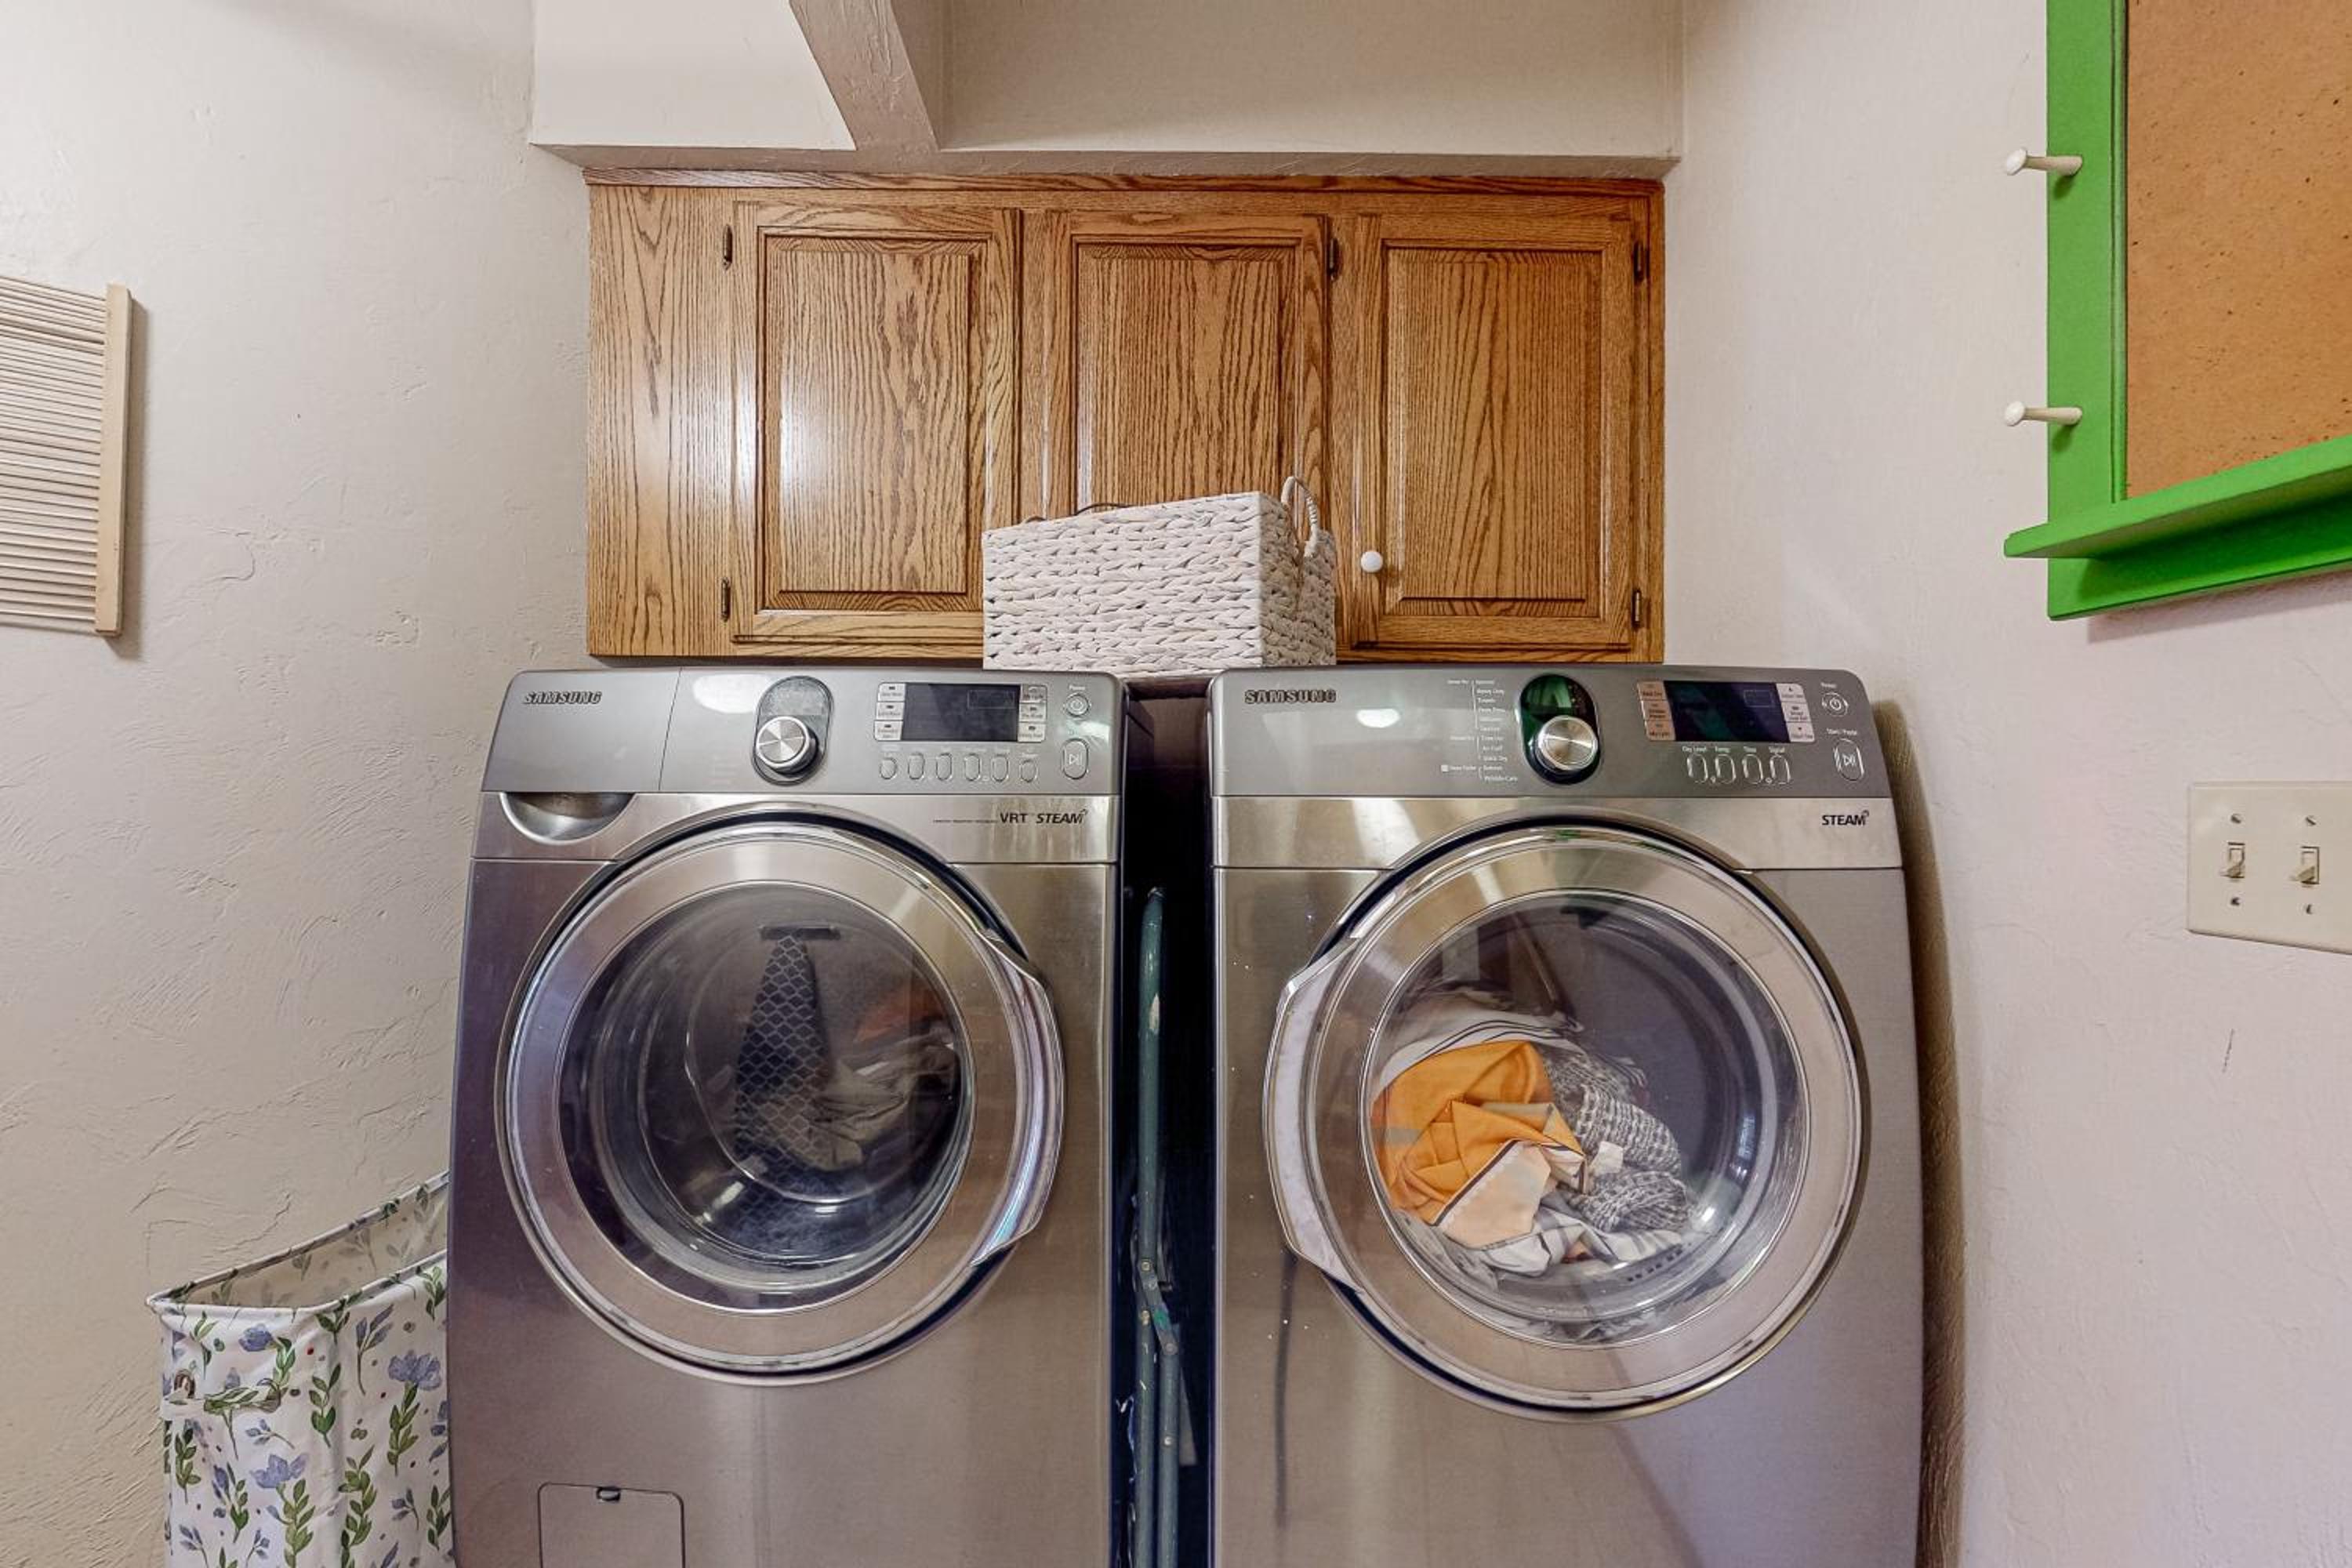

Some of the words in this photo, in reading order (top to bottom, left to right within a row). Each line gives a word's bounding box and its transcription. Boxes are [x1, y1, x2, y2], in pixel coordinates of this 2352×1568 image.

[522, 691, 602, 705] SAMSUNG
[1244, 689, 1337, 704] SAMSUNG
[1000, 812, 1028, 823] VRT
[1036, 812, 1083, 823] STEAM
[1822, 815, 1866, 826] STEAM
